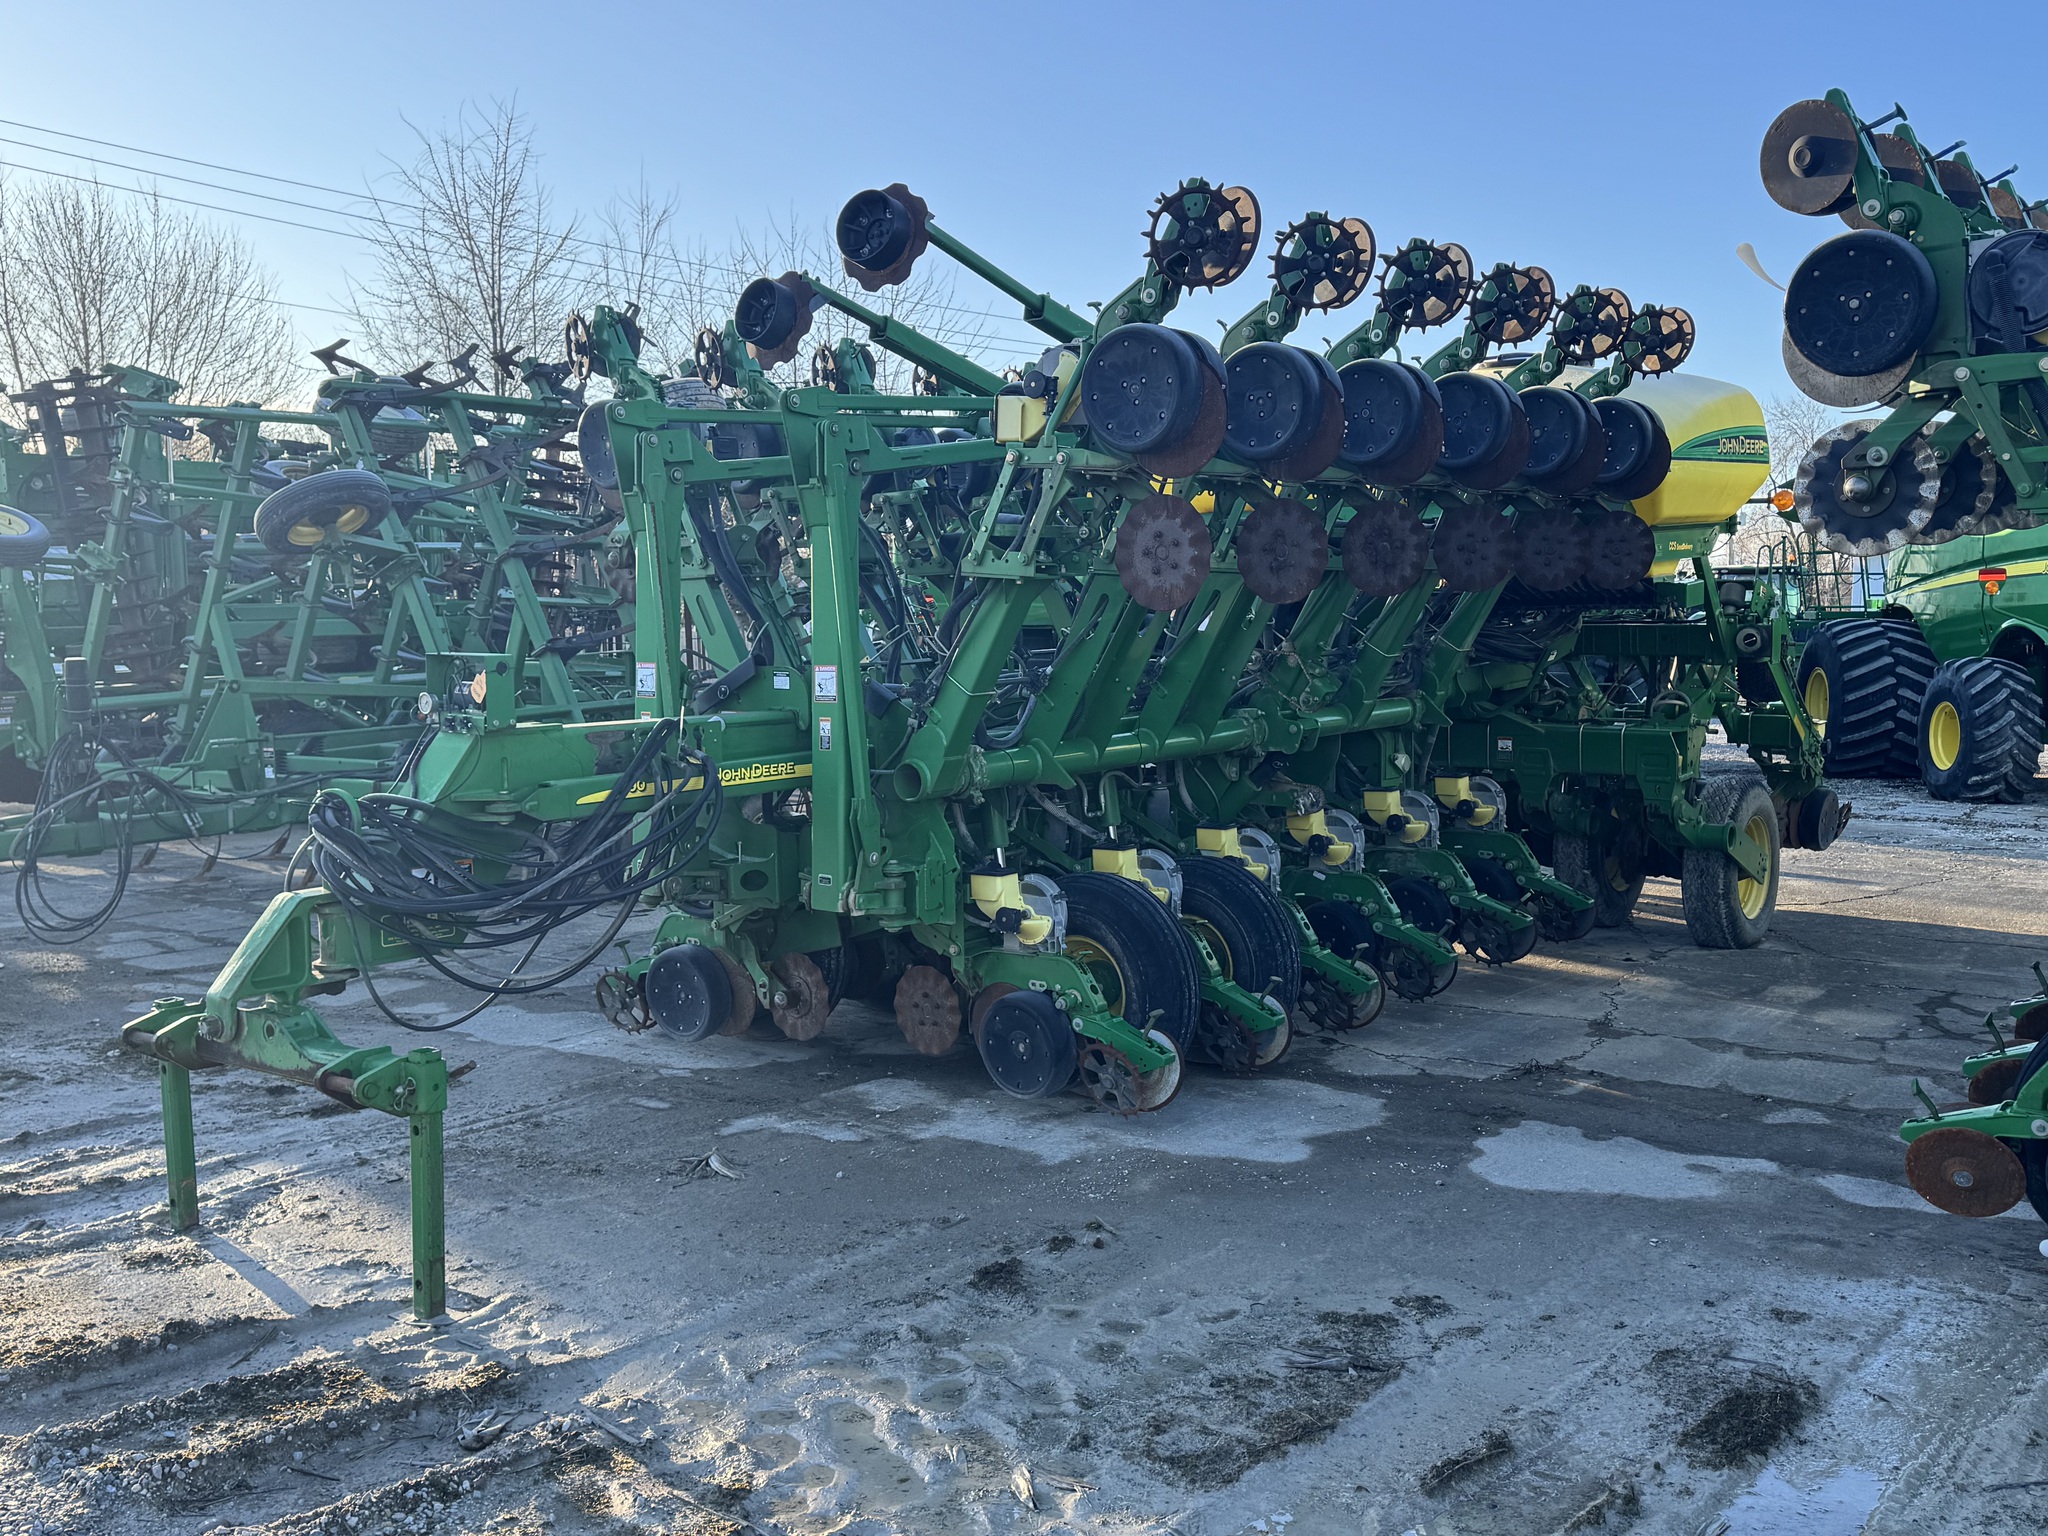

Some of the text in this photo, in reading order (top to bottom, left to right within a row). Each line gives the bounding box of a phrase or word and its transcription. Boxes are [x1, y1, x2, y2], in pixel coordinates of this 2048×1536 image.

[1717, 435, 1764, 455] JOHN DEERE
[717, 762, 795, 781] JOHN DEERE
